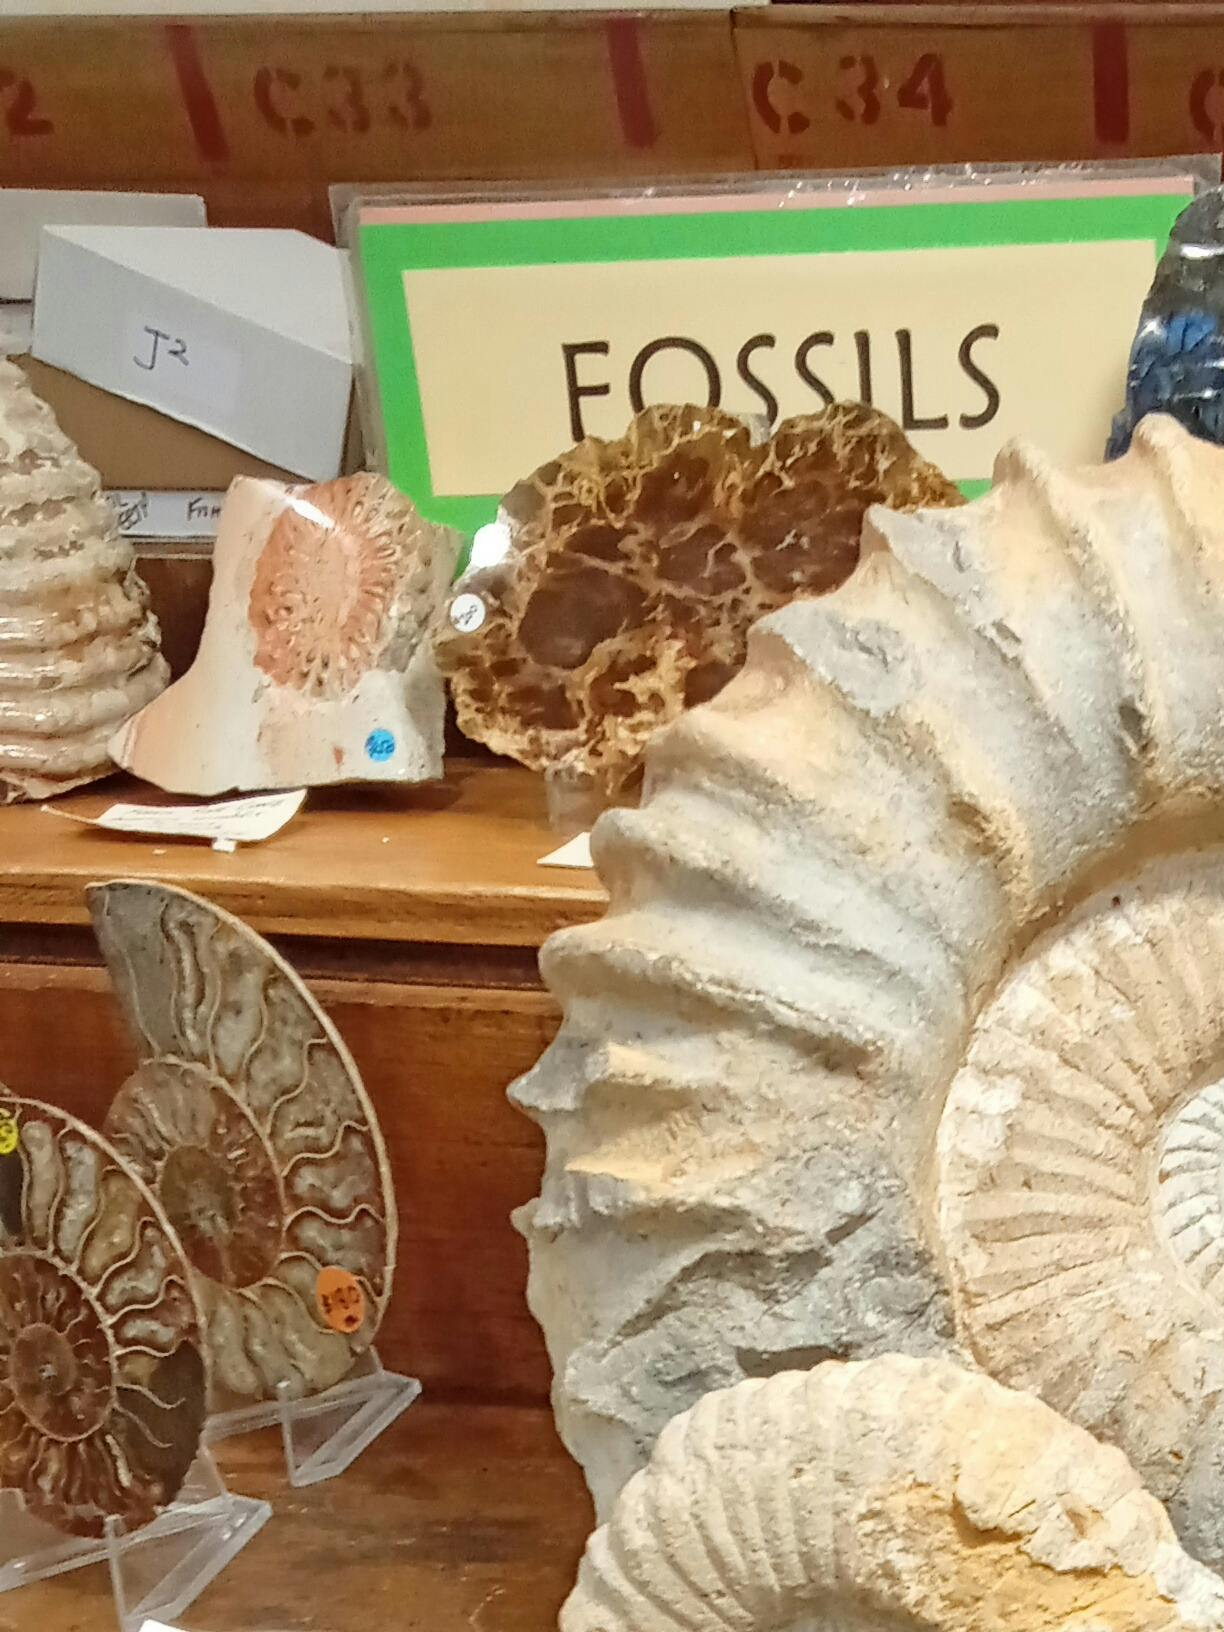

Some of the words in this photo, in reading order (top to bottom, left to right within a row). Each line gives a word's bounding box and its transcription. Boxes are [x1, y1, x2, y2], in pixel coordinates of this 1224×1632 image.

[253, 62, 433, 134] C33
[752, 53, 954, 135] C34
[561, 323, 1001, 442] FOSSILS
